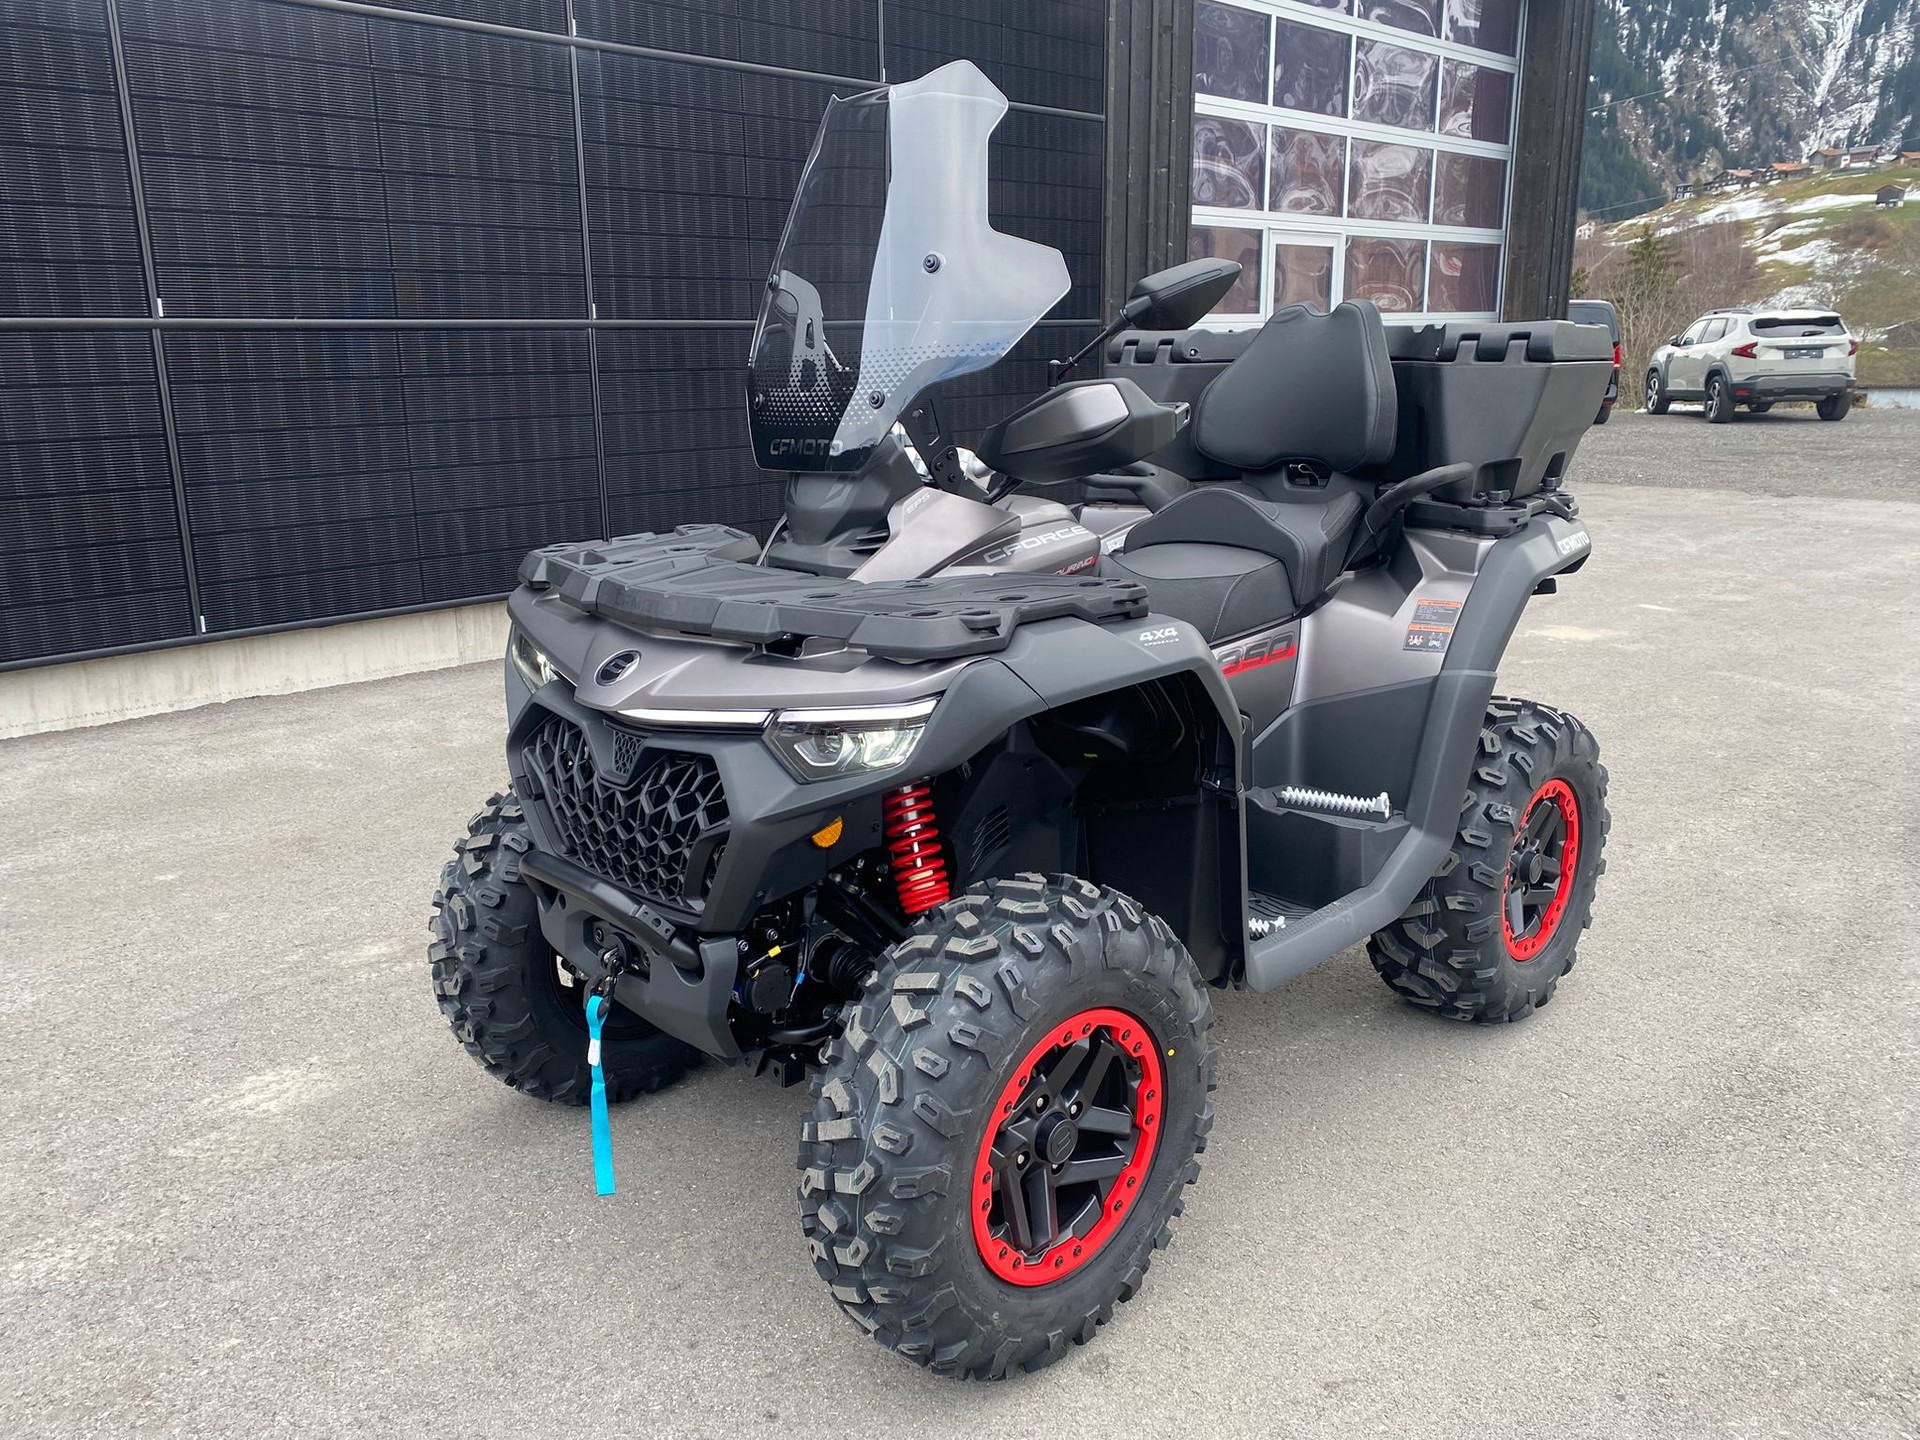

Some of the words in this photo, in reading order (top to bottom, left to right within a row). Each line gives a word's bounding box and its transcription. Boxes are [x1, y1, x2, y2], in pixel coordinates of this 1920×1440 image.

[769, 438, 844, 457] CFMOTO
[906, 492, 931, 514] EPS
[983, 525, 1090, 563] CFORCE
[1557, 530, 1591, 555] CFMOTO
